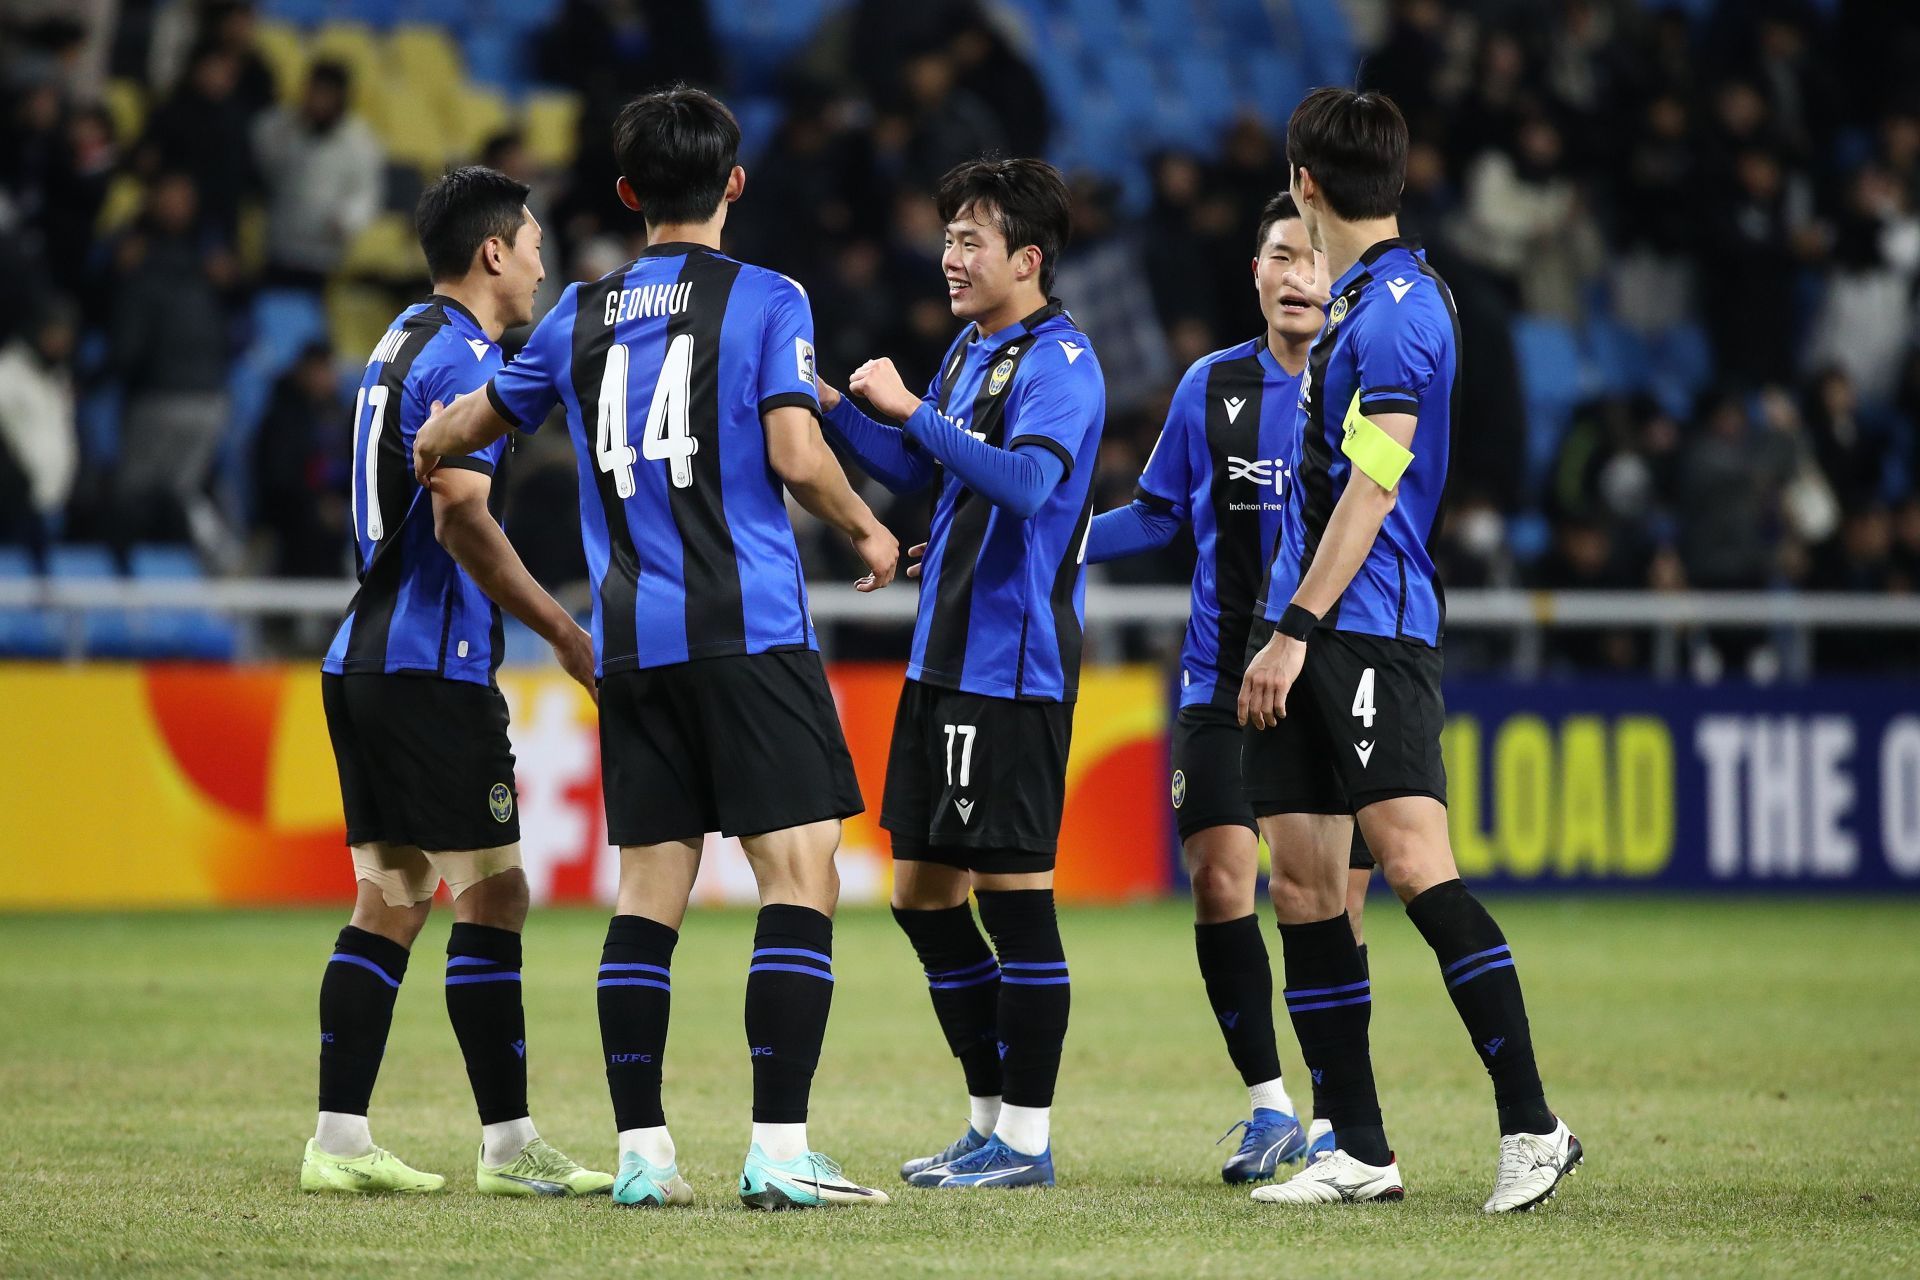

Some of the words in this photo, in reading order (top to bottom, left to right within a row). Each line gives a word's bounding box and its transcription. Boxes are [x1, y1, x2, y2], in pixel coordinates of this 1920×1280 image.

[604, 282, 693, 326] GEONHUI
[596, 334, 699, 499] 44
[1229, 502, 1261, 511] Incheon
[1263, 502, 1283, 511] Free
[1352, 668, 1377, 728] 4
[1441, 714, 1675, 878] LOAD
[1698, 714, 1858, 878] THE
